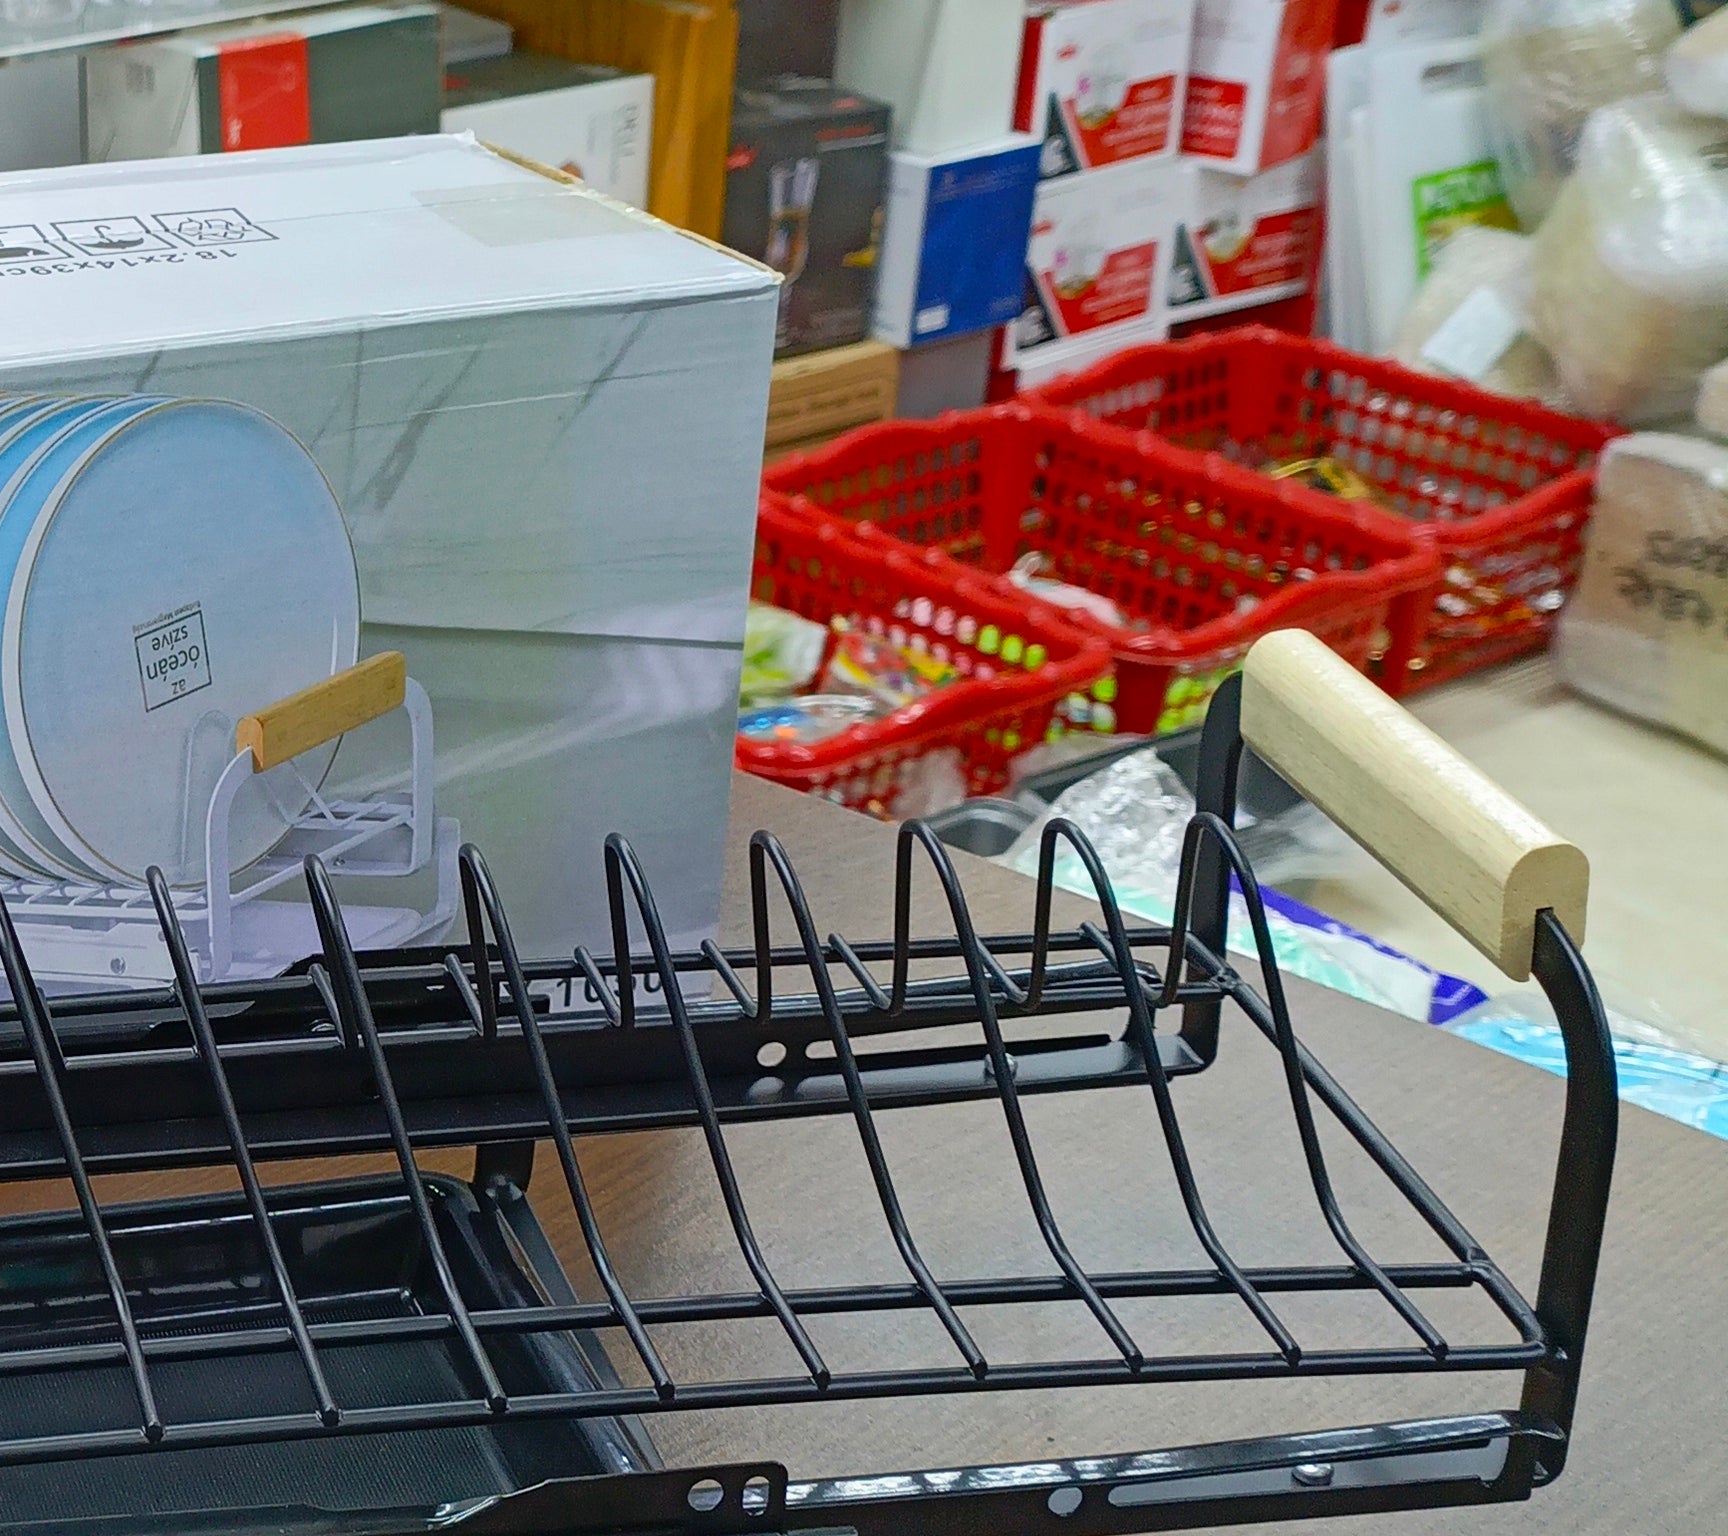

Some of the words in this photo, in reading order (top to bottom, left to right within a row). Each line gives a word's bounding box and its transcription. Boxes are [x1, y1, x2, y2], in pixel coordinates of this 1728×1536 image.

[151, 625, 188, 651] szíve
[146, 645, 200, 682] óceán
[171, 678, 186, 695] az
